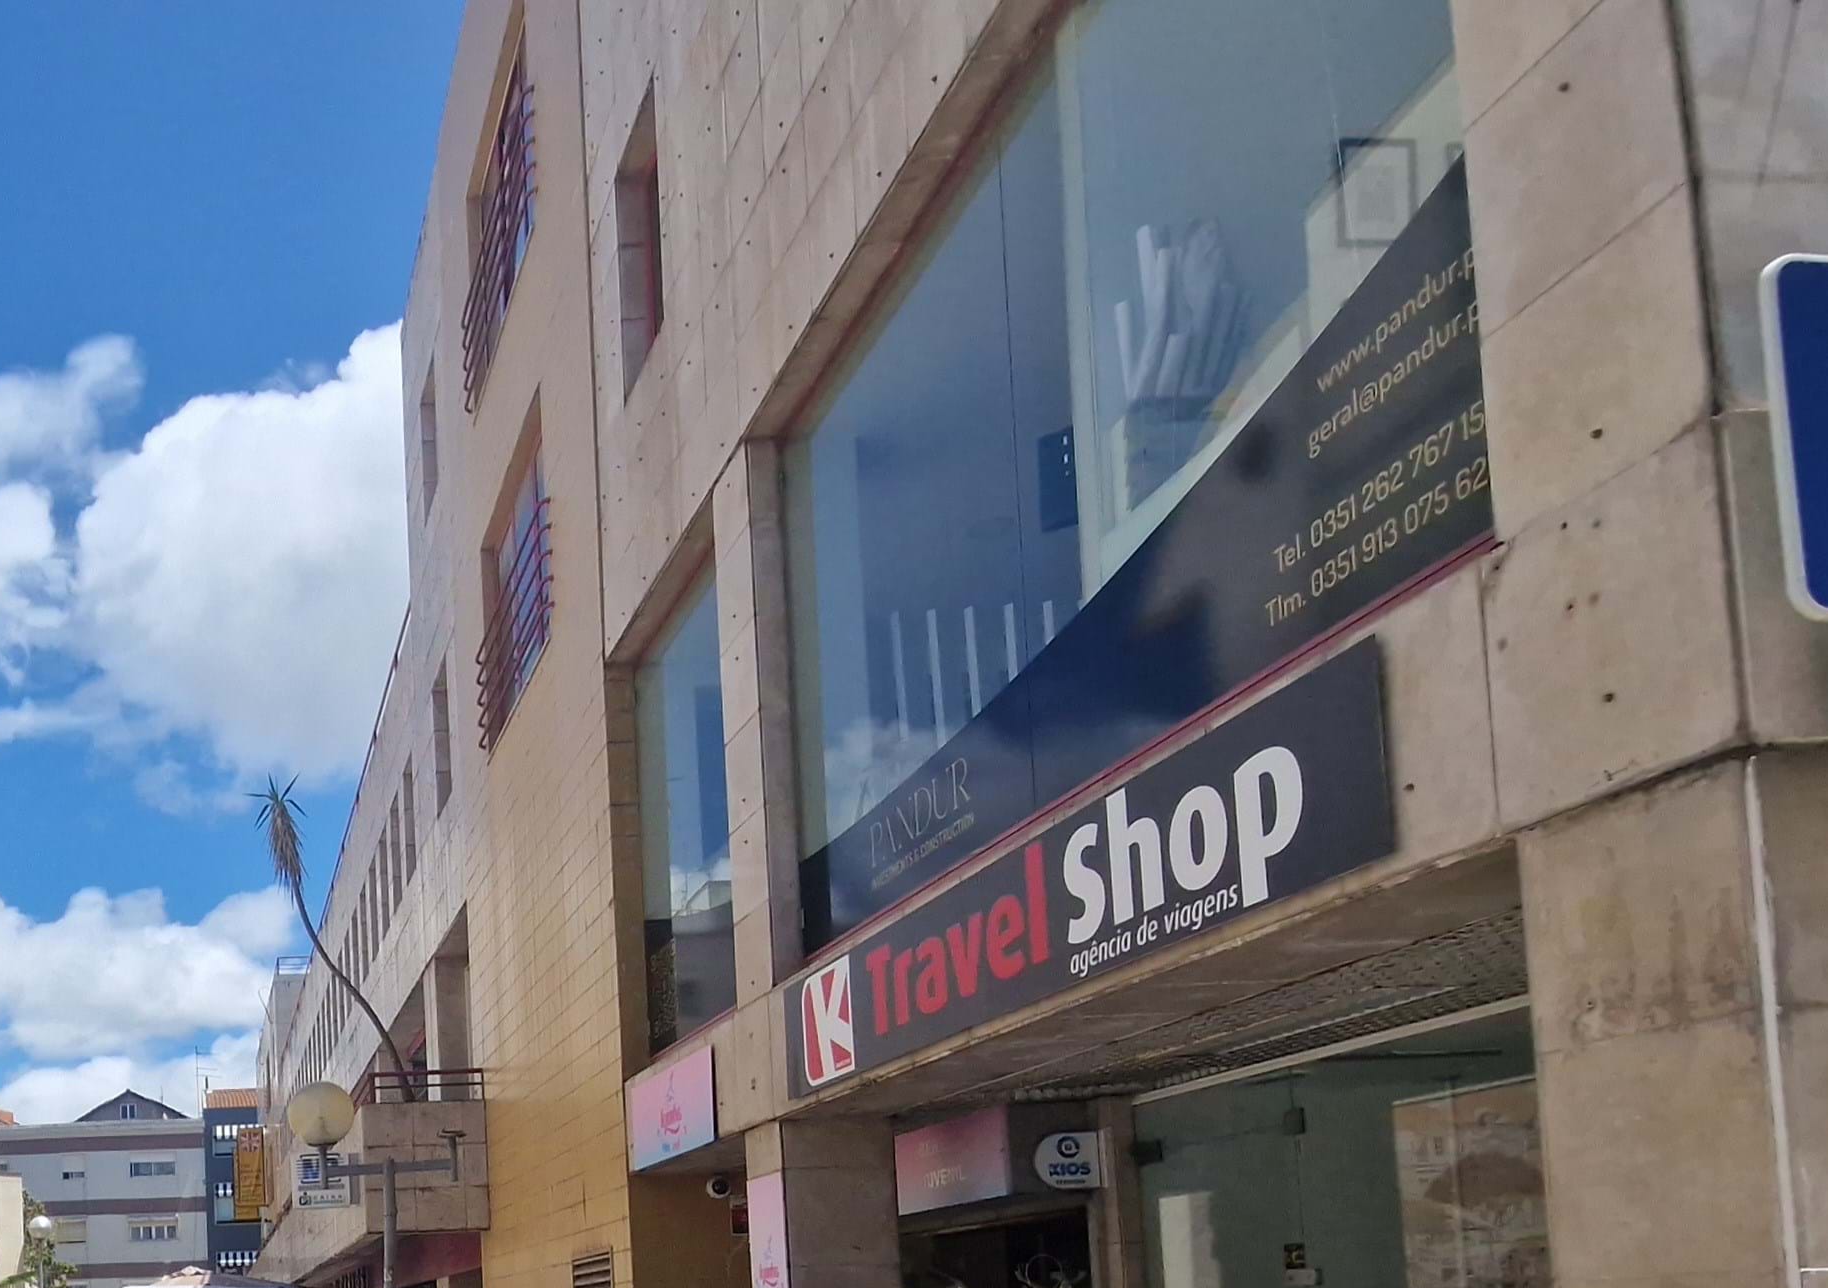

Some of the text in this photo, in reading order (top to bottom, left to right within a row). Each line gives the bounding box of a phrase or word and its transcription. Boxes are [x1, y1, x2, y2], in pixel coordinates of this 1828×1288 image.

[1265, 595, 1306, 627] Tlm.
[1311, 545, 1356, 598] 0351
[1362, 517, 1397, 564] 913
[1404, 482, 1448, 534] 075
[1273, 533, 1306, 573] Tel.
[1310, 494, 1355, 548] 0351
[1362, 460, 1403, 513] 262
[1410, 424, 1455, 478] 767
[870, 758, 971, 868] PANDUR
[865, 745, 1303, 1036] Travel Shop
[1070, 884, 1239, 978] agência de viagens
